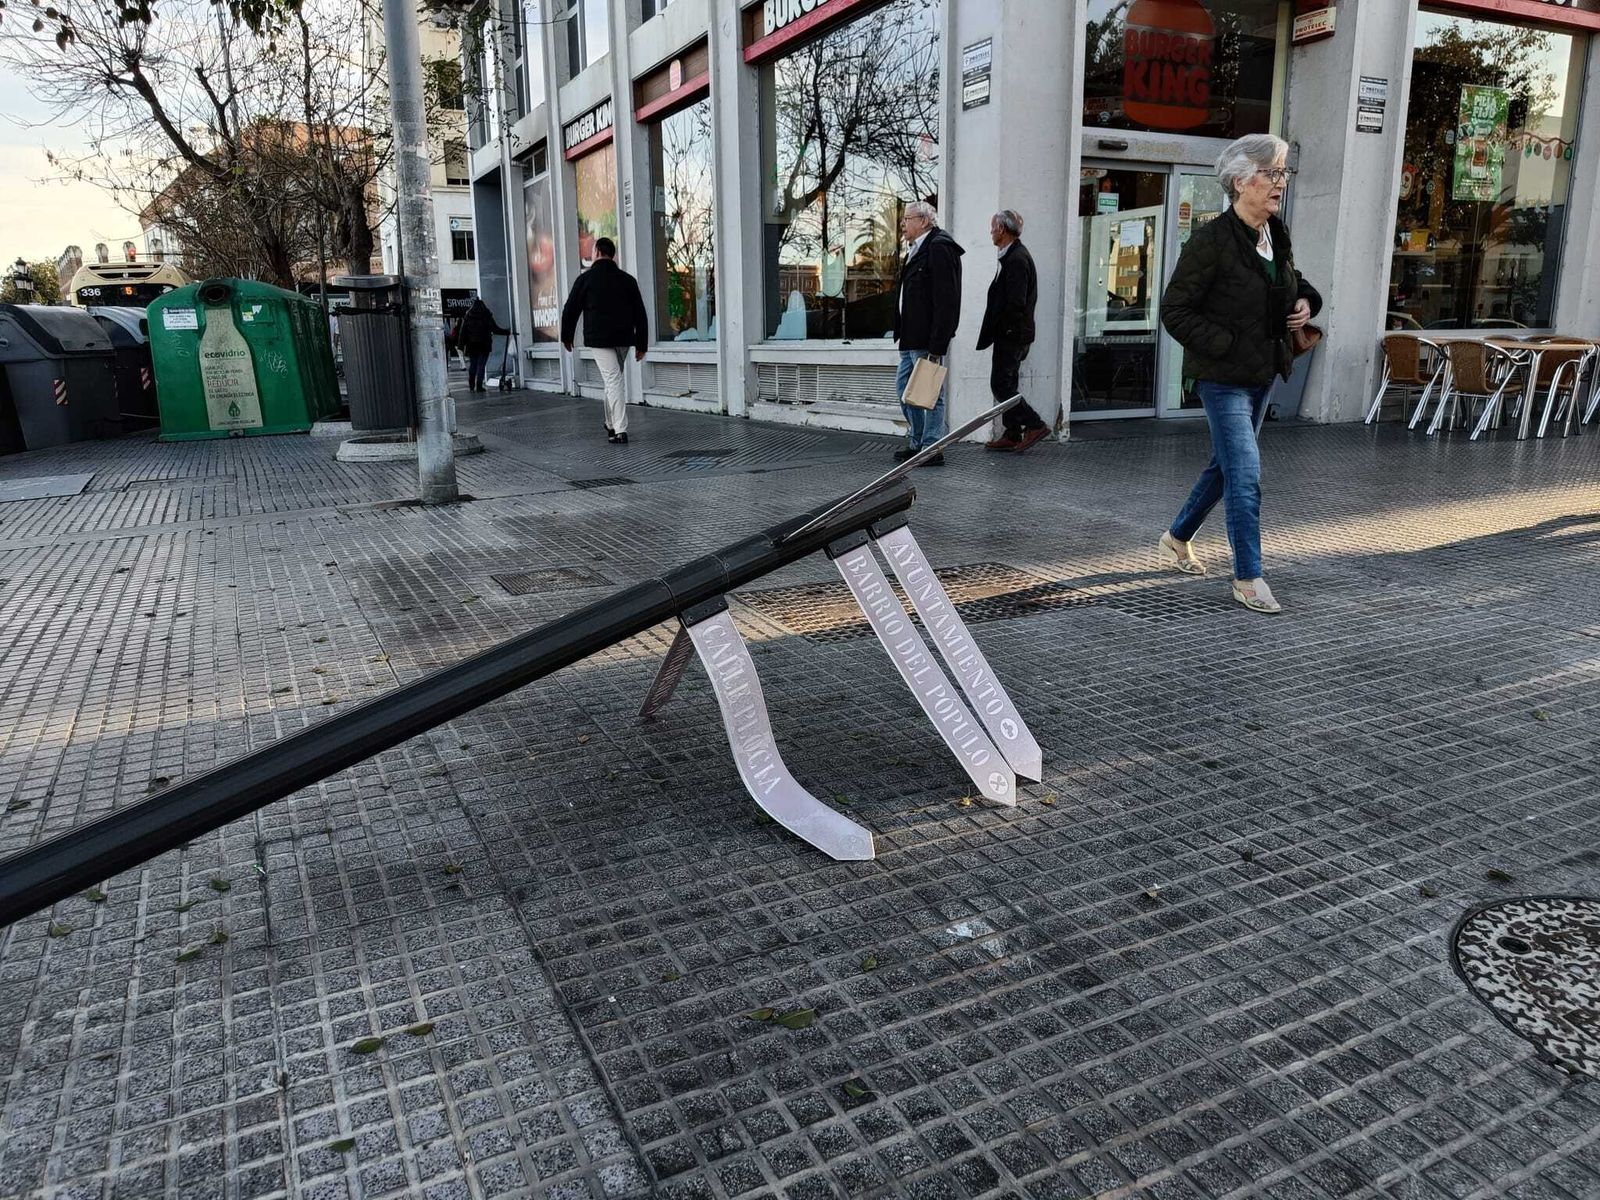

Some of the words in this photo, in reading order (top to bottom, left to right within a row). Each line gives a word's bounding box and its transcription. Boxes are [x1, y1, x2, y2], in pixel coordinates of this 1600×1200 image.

[1123, 28, 1212, 65] BURGER
[1122, 60, 1210, 105] KING
[565, 112, 596, 150] BURGER
[595, 101, 615, 133] KIN
[81, 287, 101, 297] 336
[125, 286, 133, 296] 5
[204, 349, 246, 359] ecovidrio
[889, 542, 1005, 716] AYUNTAMIENTO
[701, 623, 752, 707] CALLE
[846, 554, 904, 636] BARRIO
[895, 637, 932, 685] DEL
[924, 684, 992, 768] PÓPULO
